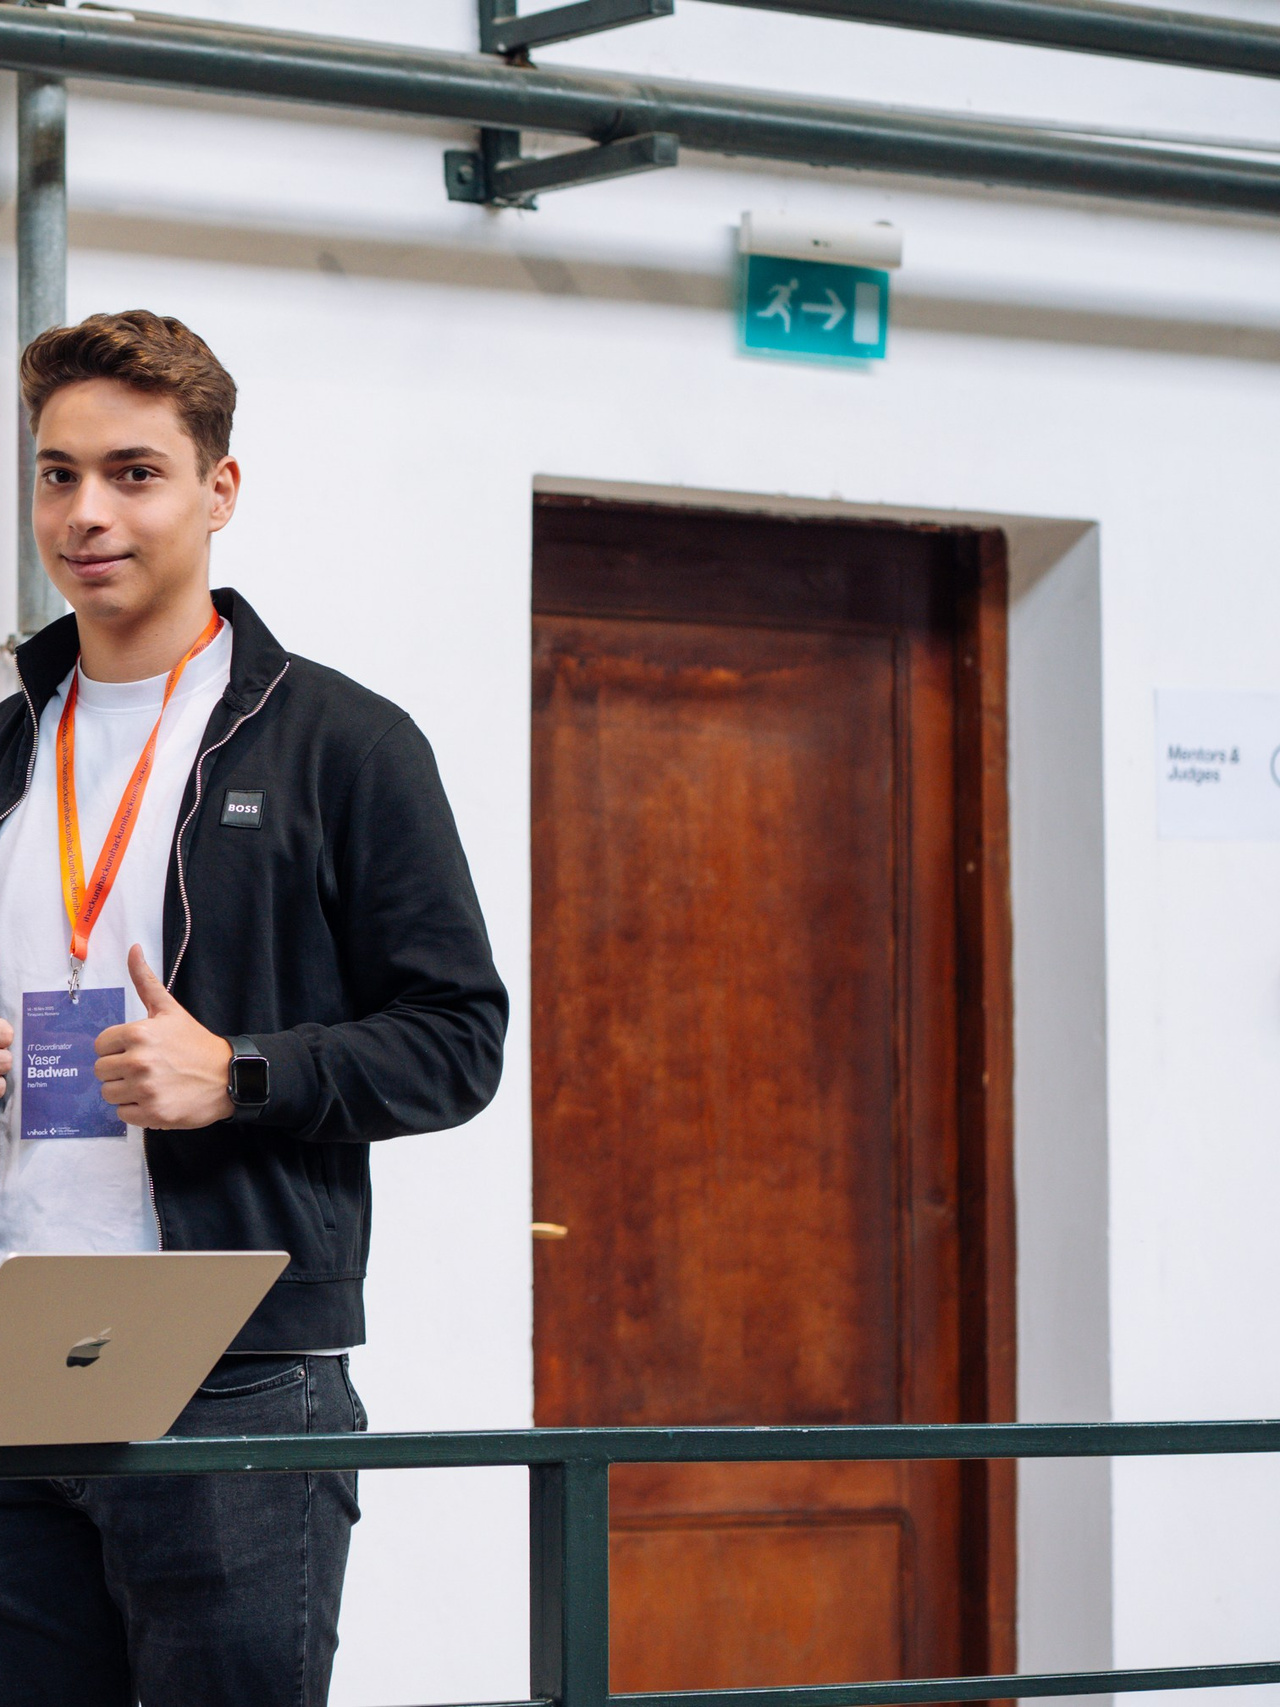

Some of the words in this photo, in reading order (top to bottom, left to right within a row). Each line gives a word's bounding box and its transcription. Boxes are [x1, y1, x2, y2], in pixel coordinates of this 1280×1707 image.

[1167, 744, 1226, 763] Mentors
[1230, 746, 1240, 764] &
[1167, 766, 1221, 787] Judges
[228, 803, 258, 814] BOSS
[35, 1043, 73, 1051] Coordinator
[27, 1053, 61, 1066] Yaser
[27, 1066, 79, 1078] Badwan
